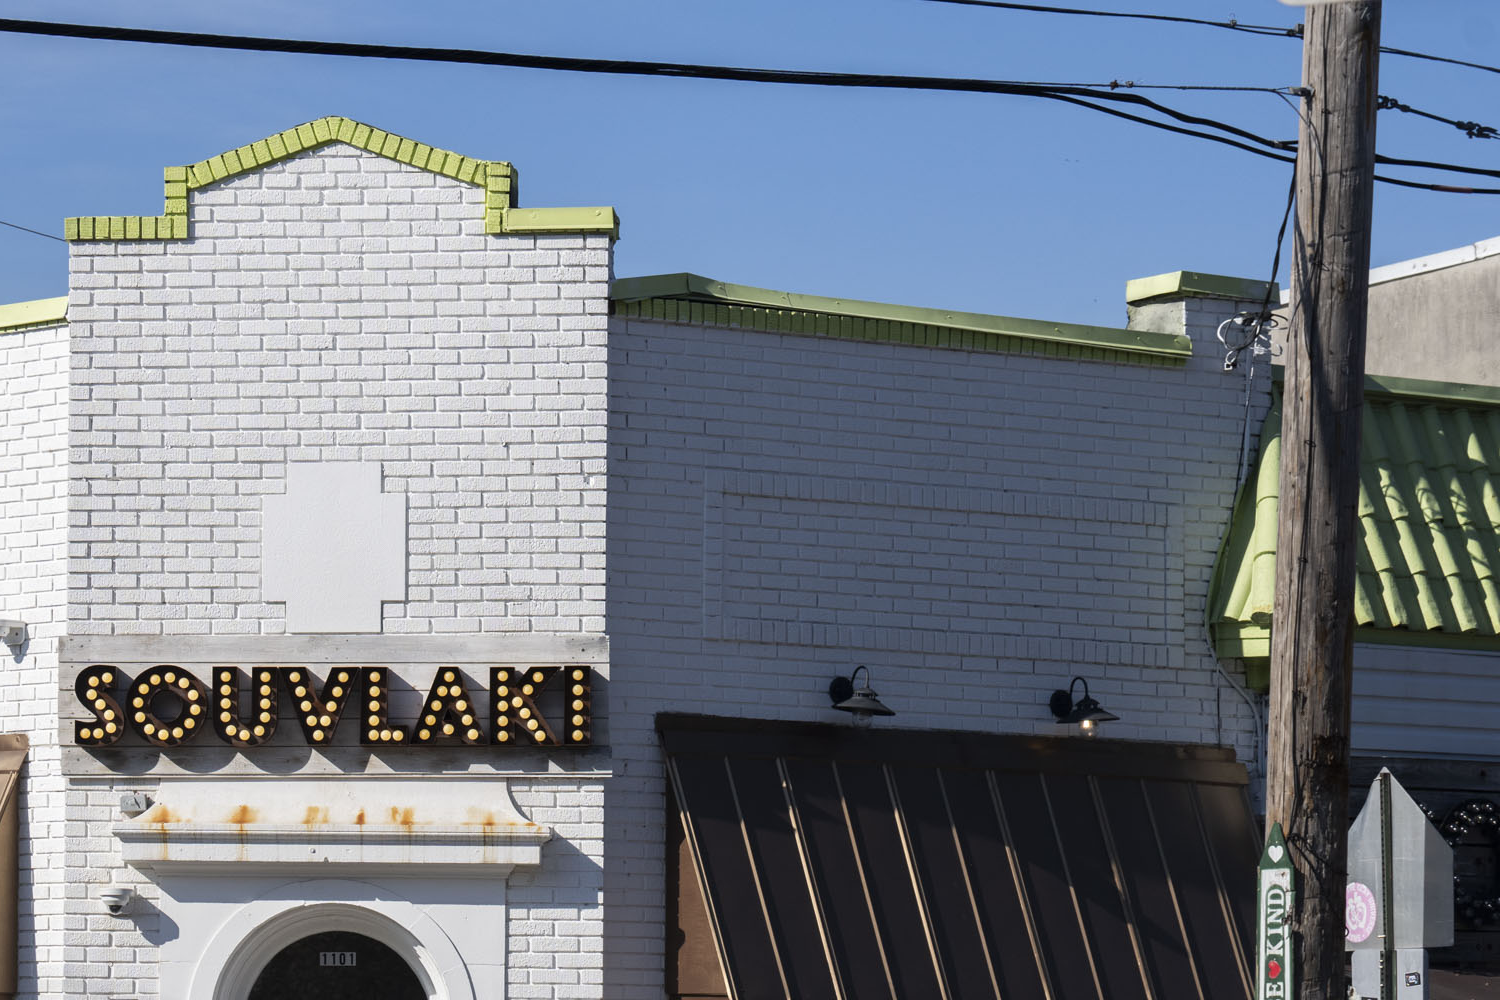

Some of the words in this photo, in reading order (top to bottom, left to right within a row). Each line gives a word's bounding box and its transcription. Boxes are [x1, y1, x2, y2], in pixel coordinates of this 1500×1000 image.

[74, 663, 591, 749] SOUVLAKI
[1266, 888, 1285, 957] KIND
[322, 953, 354, 965] 1101
